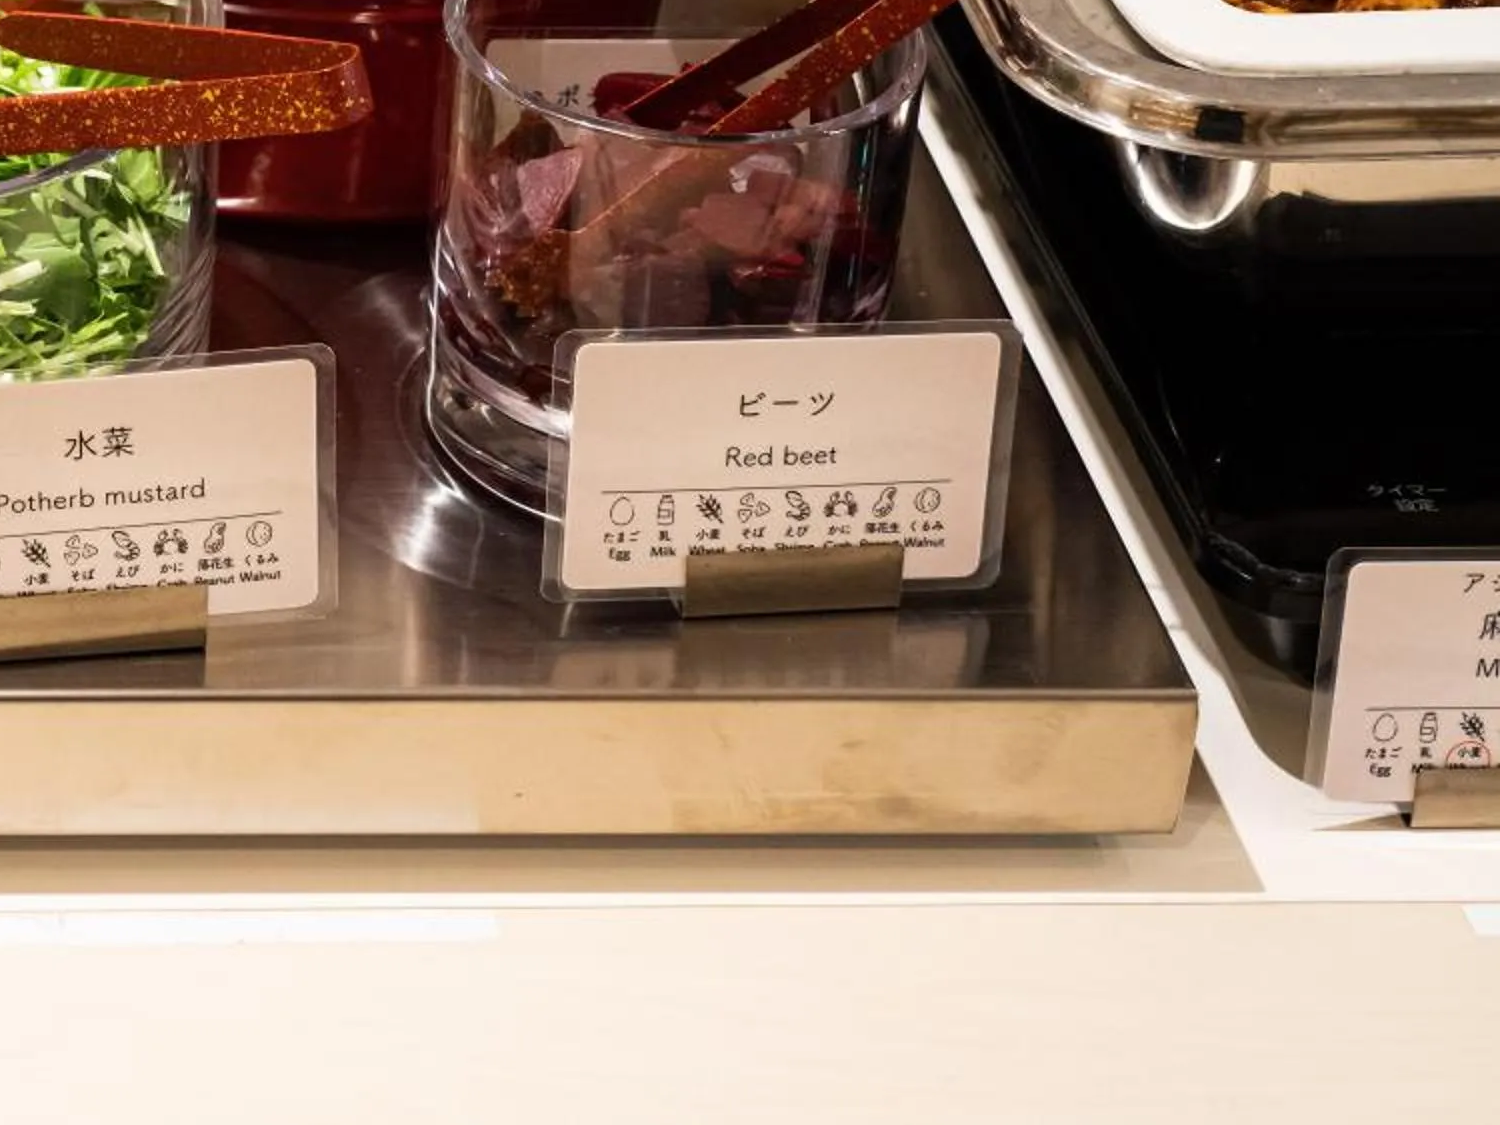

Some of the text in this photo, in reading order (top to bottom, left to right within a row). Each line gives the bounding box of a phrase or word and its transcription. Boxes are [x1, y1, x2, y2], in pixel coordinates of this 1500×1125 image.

[739, 392, 836, 418] ビーツ
[64, 426, 136, 461] 水菜
[725, 445, 838, 468] Red beet
[104, 477, 207, 507] mustard
[608, 546, 632, 562] Egg
[650, 546, 677, 557] Milk
[903, 537, 946, 549] Walnut
[240, 569, 282, 583] Walnut
[1369, 763, 1392, 778] Egg
